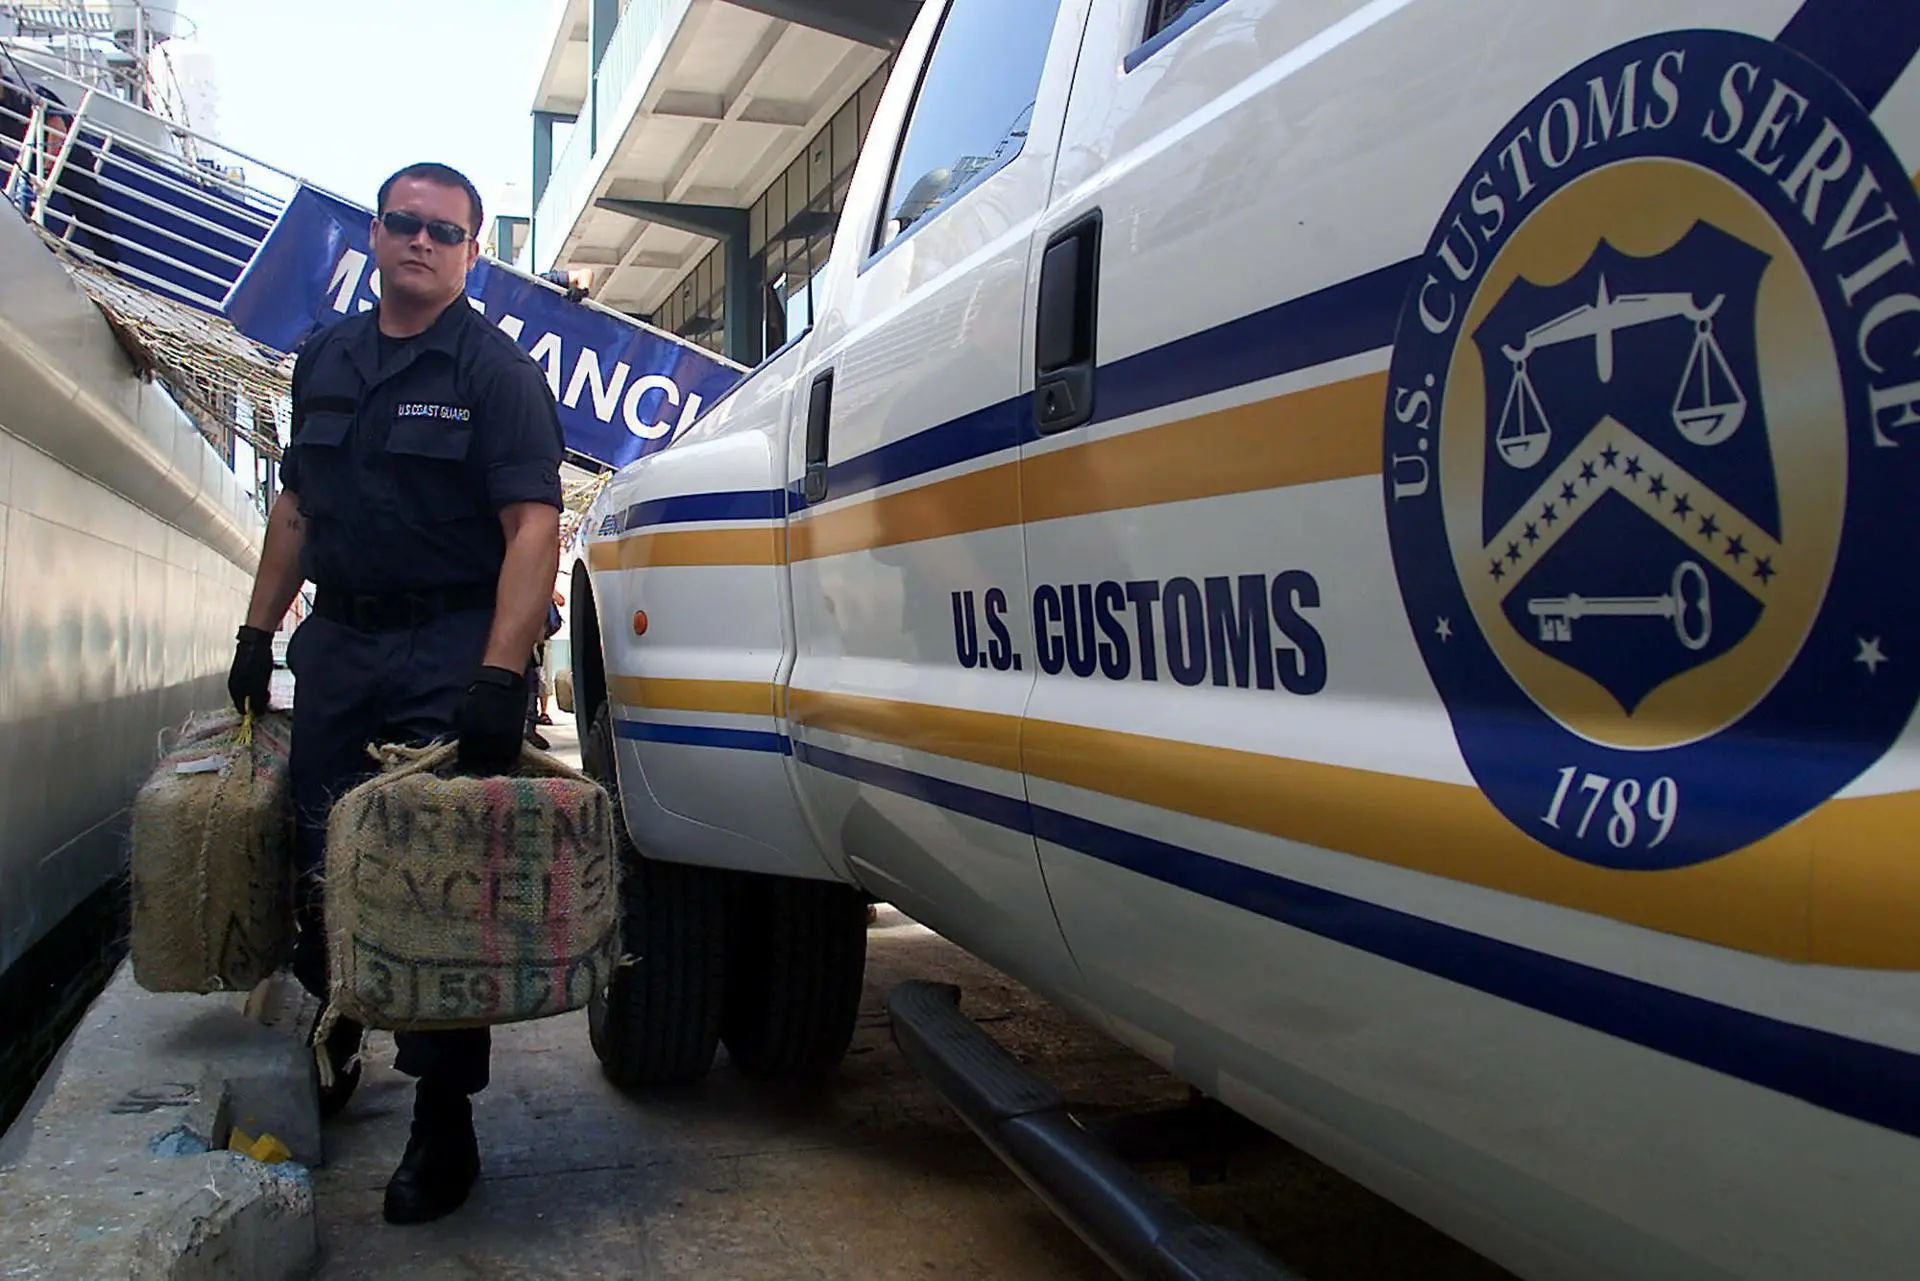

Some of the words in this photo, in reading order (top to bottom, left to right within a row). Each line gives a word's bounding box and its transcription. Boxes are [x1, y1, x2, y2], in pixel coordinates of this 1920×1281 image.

[1392, 373, 1436, 502] U.S.
[1418, 49, 1686, 335] CUSTOMS
[1701, 60, 1919, 448] SERVICE
[411, 404, 440, 418] COAST
[440, 406, 471, 421] GUARD
[951, 587, 1022, 671] U.S.
[1033, 569, 1328, 696] CUSTOMS
[1540, 765, 1678, 849] 1789
